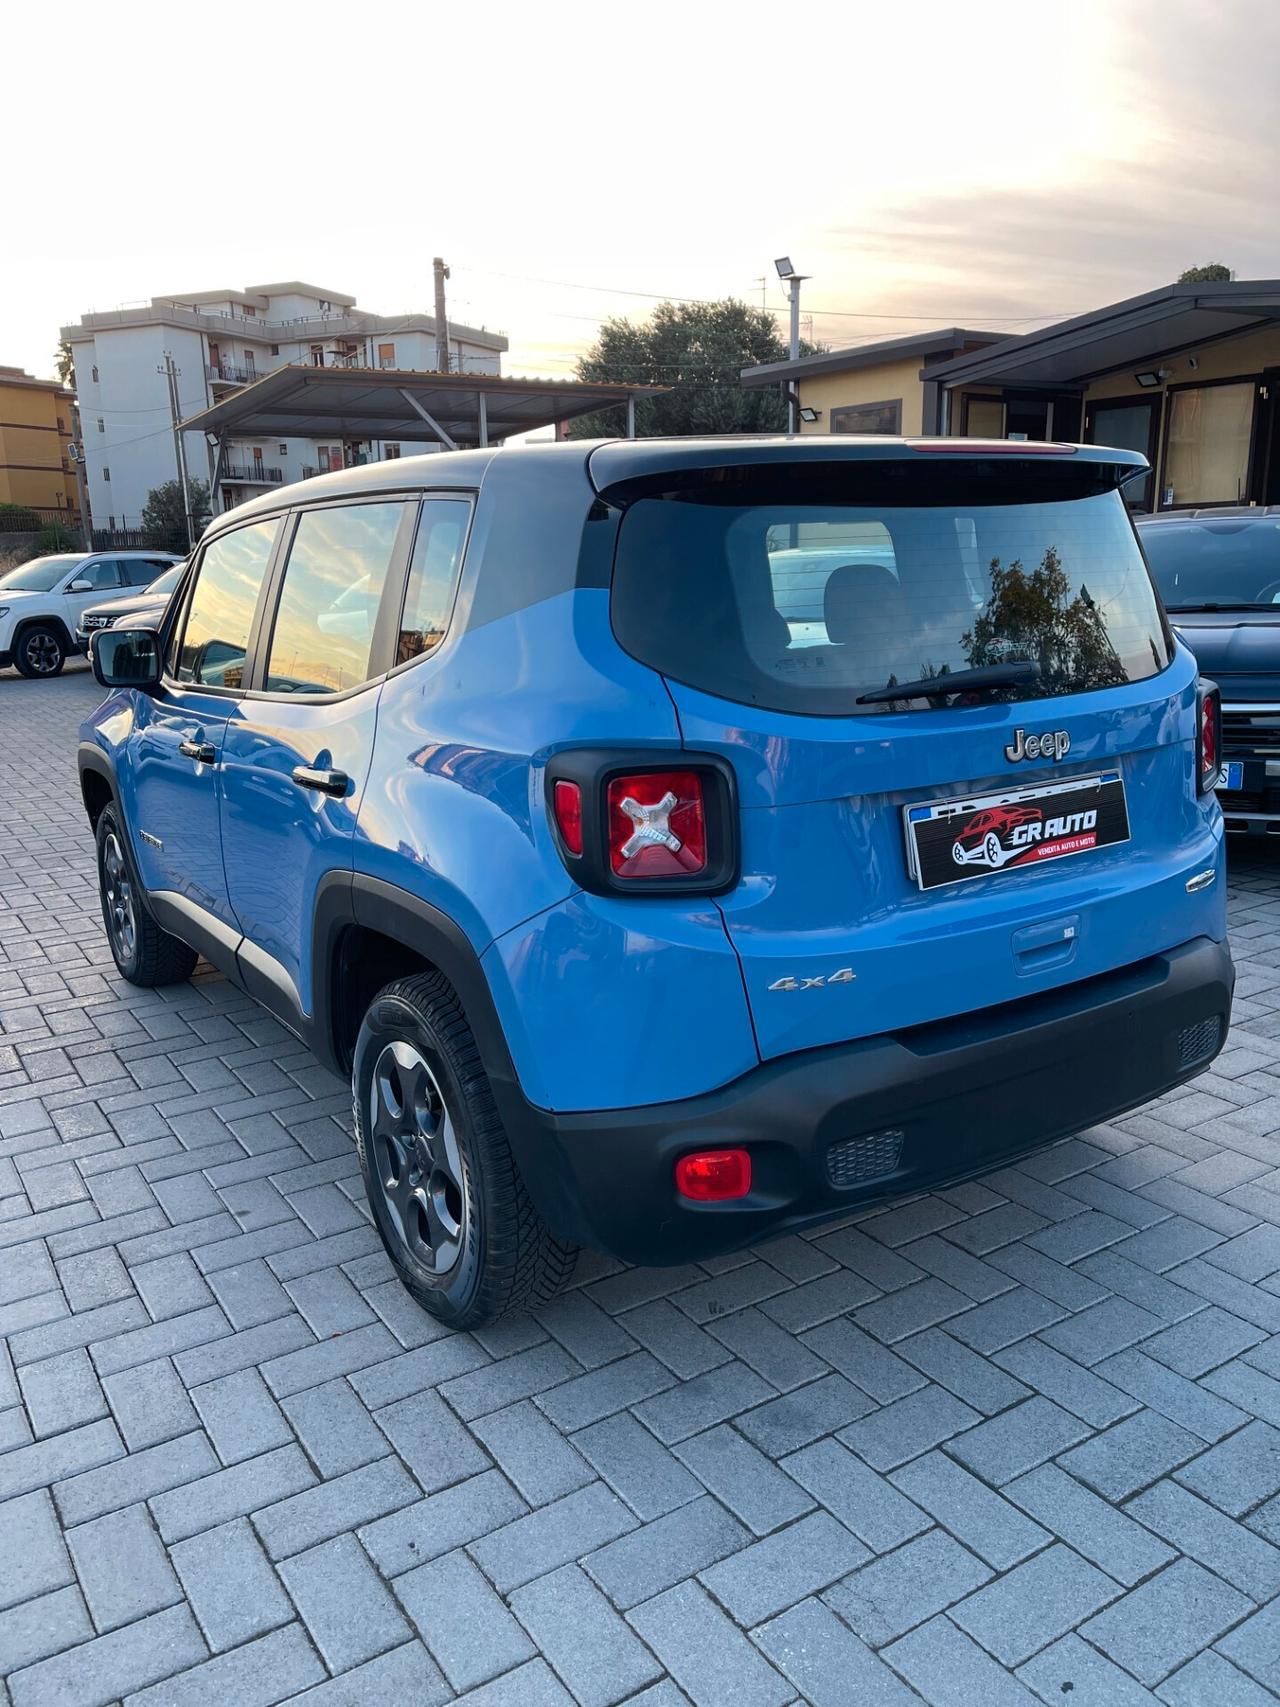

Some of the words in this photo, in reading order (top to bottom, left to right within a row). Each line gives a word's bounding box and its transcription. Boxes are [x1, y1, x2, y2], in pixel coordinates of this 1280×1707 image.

[1006, 729, 1070, 761] Jeep
[1044, 809, 1097, 838] AUTO
[1038, 845, 1061, 855] VENDITA
[1061, 841, 1075, 850] AUTO
[1080, 836, 1095, 846] MOTO
[767, 967, 857, 991] 4x4
